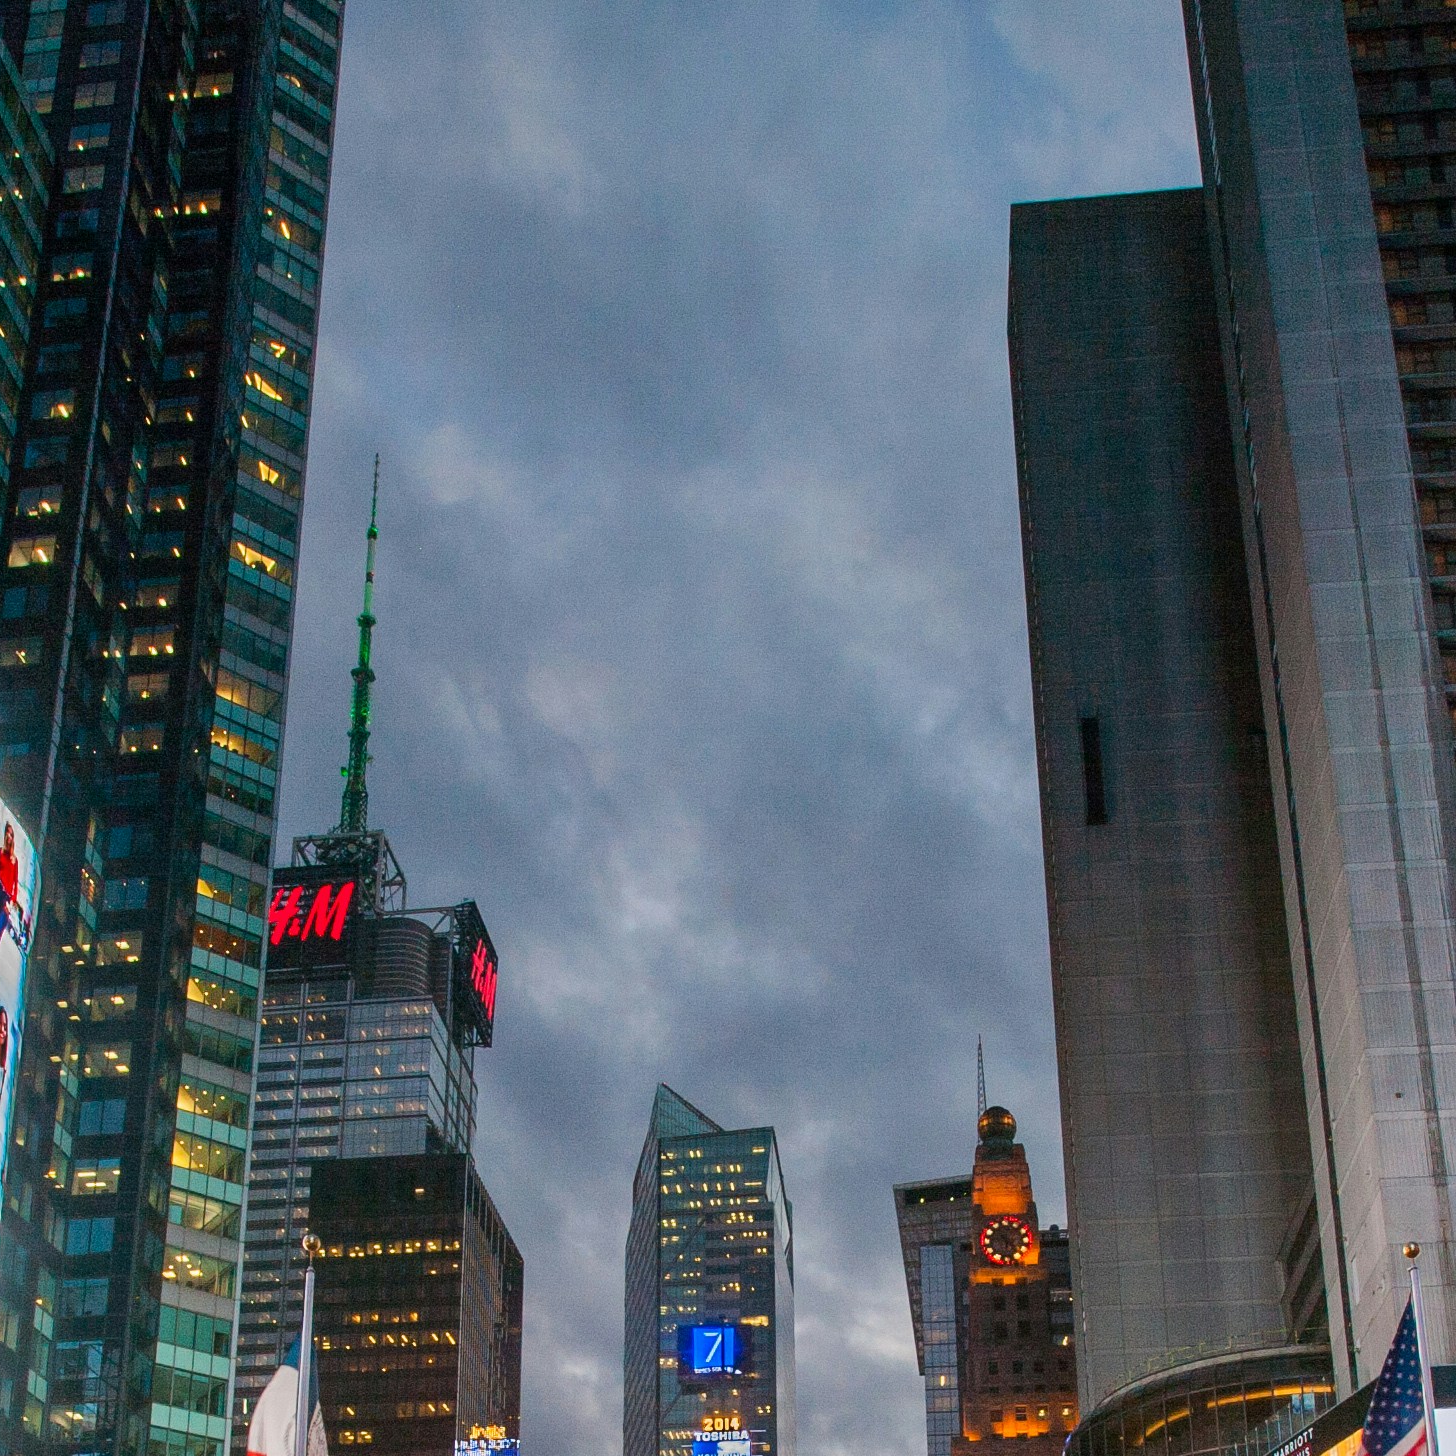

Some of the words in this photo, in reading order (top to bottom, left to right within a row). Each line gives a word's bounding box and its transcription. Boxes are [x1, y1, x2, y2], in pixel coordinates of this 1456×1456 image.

[269, 881, 354, 945] H&M
[704, 1332, 722, 1363] 7
[704, 1417, 739, 1431] 2014
[694, 1431, 749, 1441] TOSHIBA
